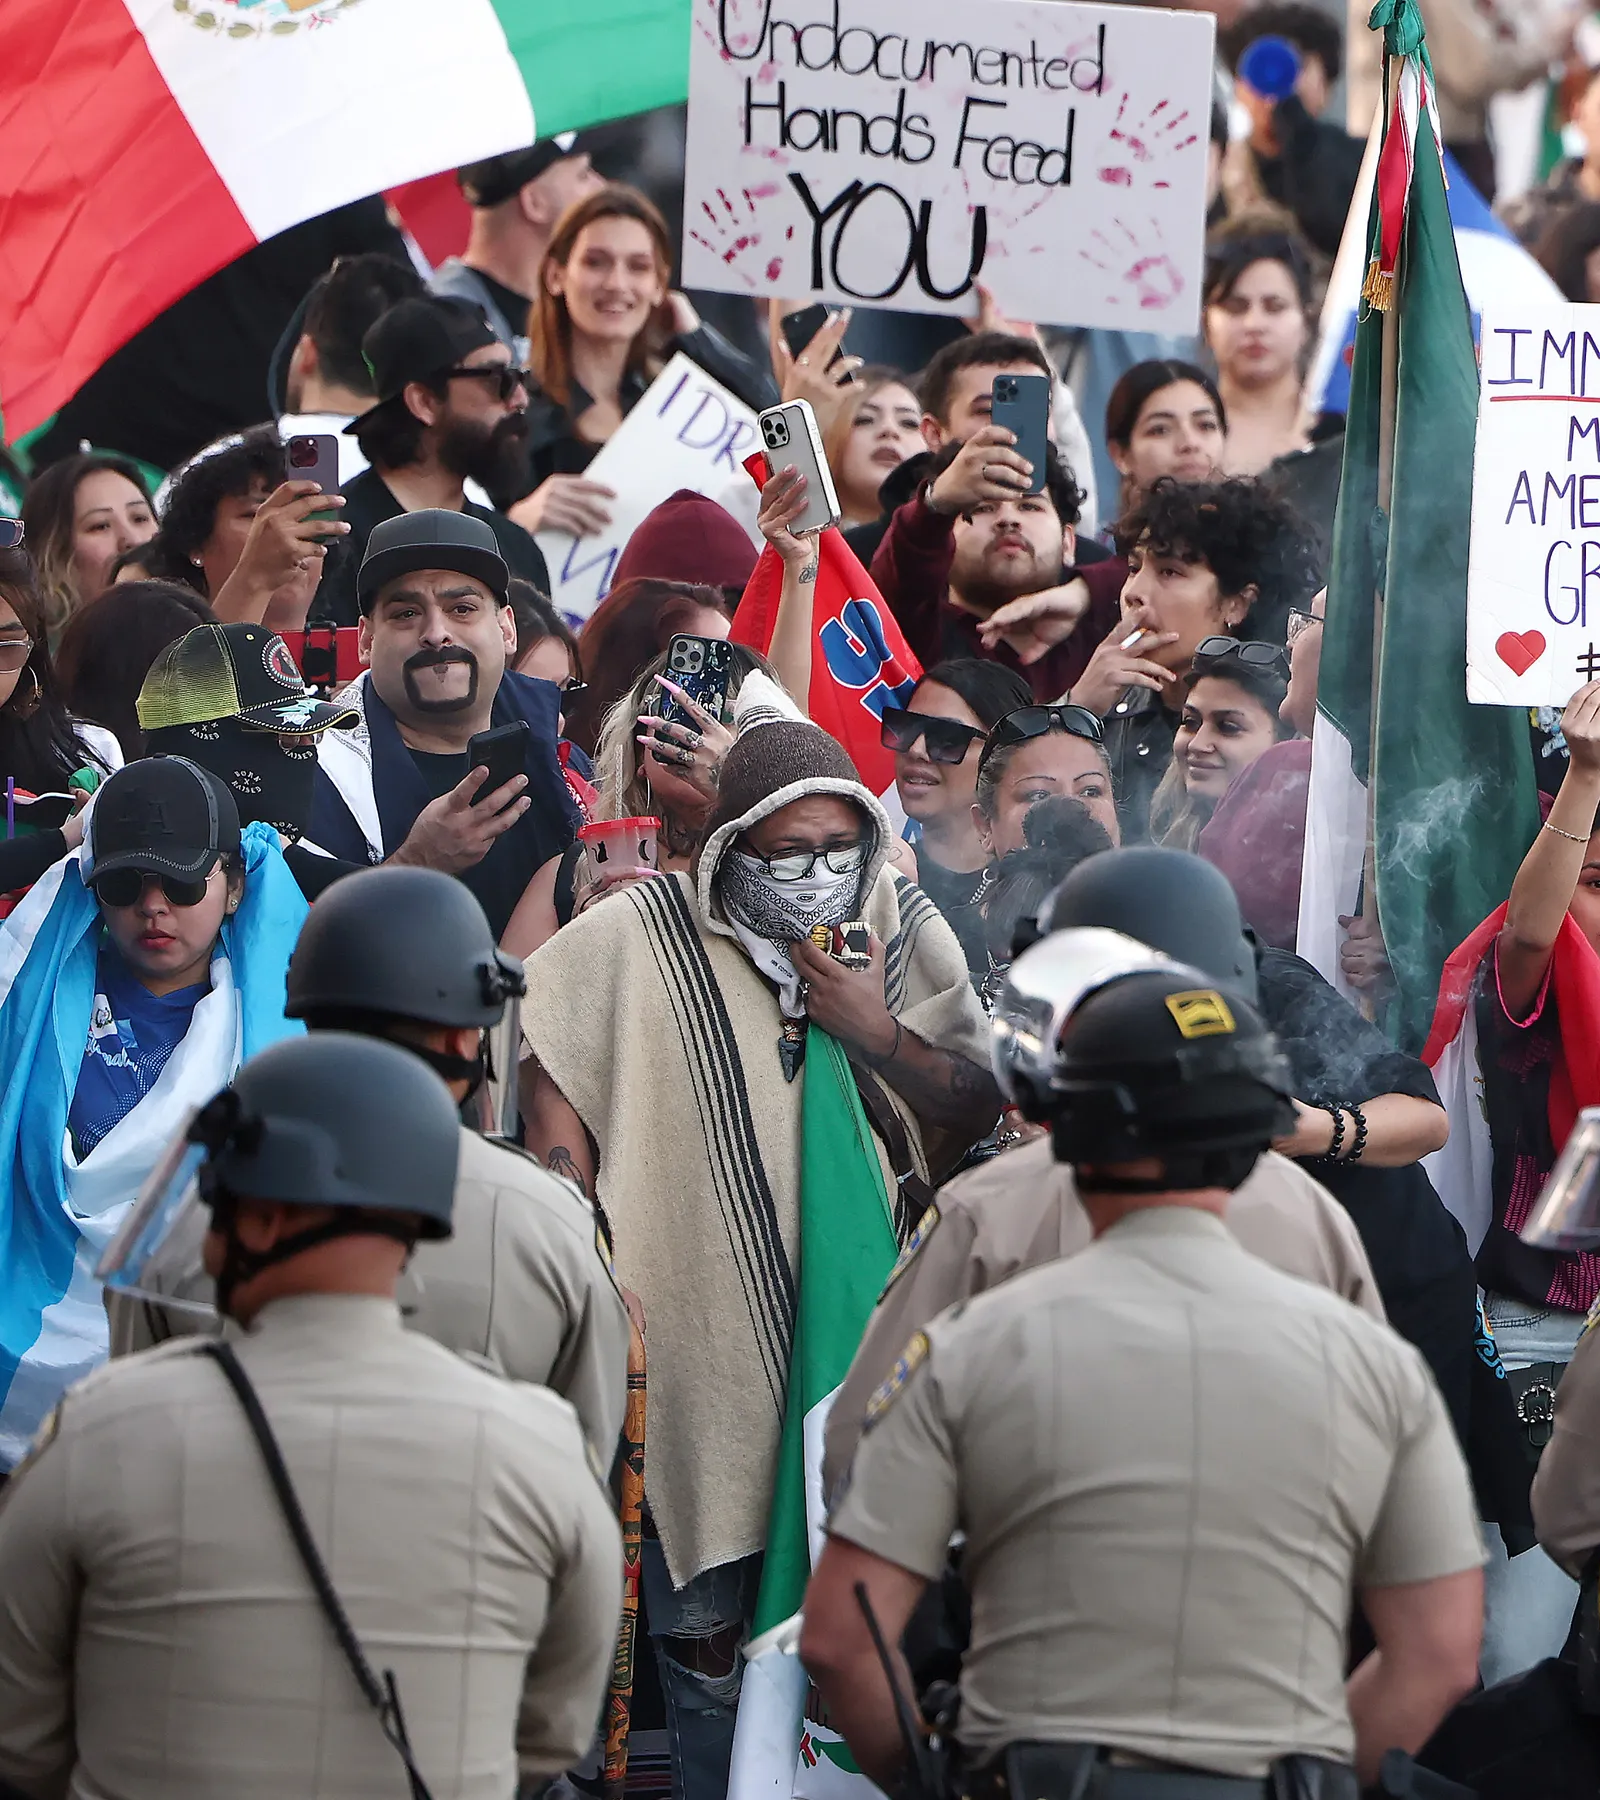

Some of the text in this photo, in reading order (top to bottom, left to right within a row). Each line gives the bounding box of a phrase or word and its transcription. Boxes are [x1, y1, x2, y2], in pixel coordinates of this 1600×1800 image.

[719, 0, 1106, 96] Undocumented
[745, 77, 1075, 187] Hands Feed
[788, 172, 987, 300] YOU
[657, 372, 690, 418] I
